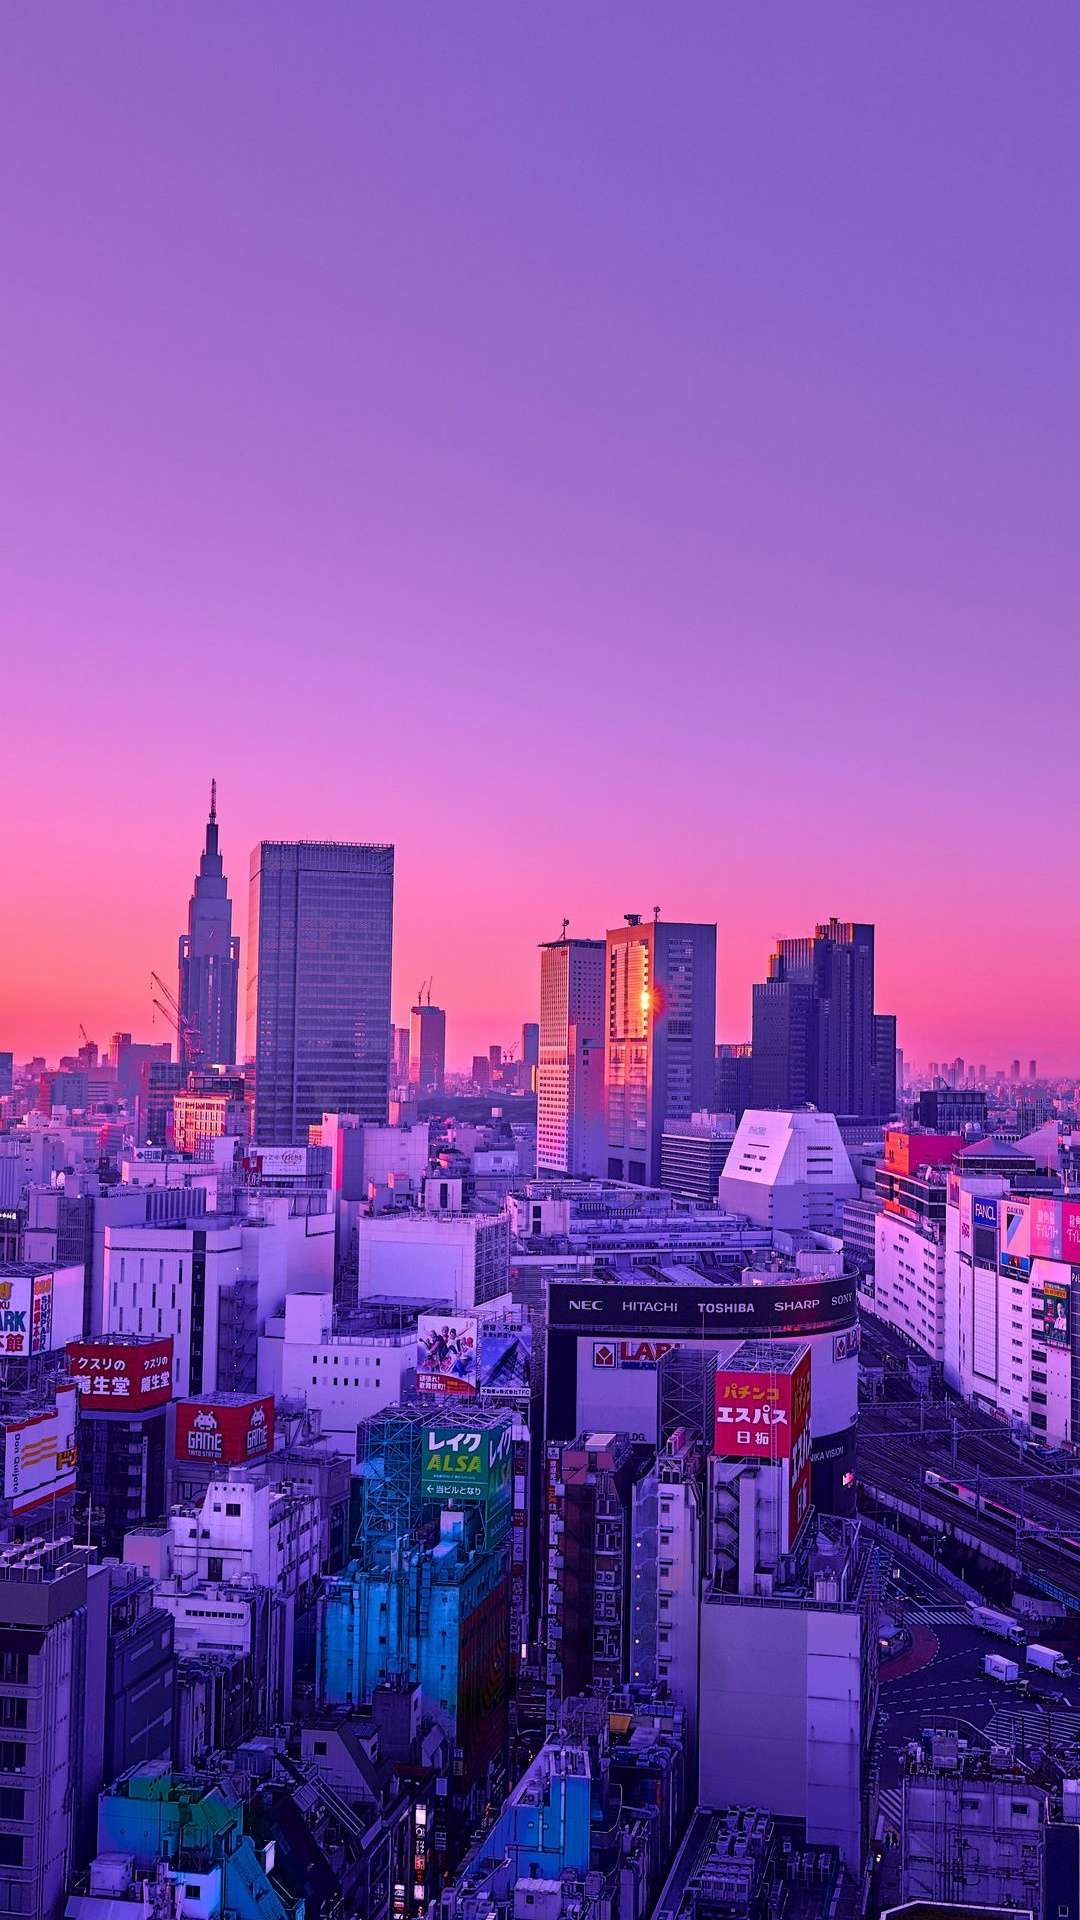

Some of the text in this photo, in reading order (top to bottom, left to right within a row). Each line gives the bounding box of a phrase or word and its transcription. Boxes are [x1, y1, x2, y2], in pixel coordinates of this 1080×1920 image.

[975, 1203, 996, 1221] FANCL
[1006, 1206, 1024, 1216] DAIKIN
[569, 1292, 853, 1313] NEC HITACHI TOSHIBA SHARP SONY
[40, 1295, 48, 1351] SUNPARK
[78, 1357, 126, 1371] クスリの
[143, 1356, 168, 1370] クスリの
[723, 1382, 779, 1400] パチンコ
[716, 1404, 788, 1425] エスパス
[187, 1430, 223, 1451] GAME
[247, 1425, 267, 1449] GAME
[428, 1431, 482, 1452] レイク
[737, 1430, 769, 1445] 日拓
[489, 1427, 511, 1468] レイク
[825, 1445, 844, 1459] VISION
[426, 1454, 482, 1473] ALSA
[12, 1456, 20, 1493] Quijote
[435, 1484, 481, 1495] 当ビルとなり
